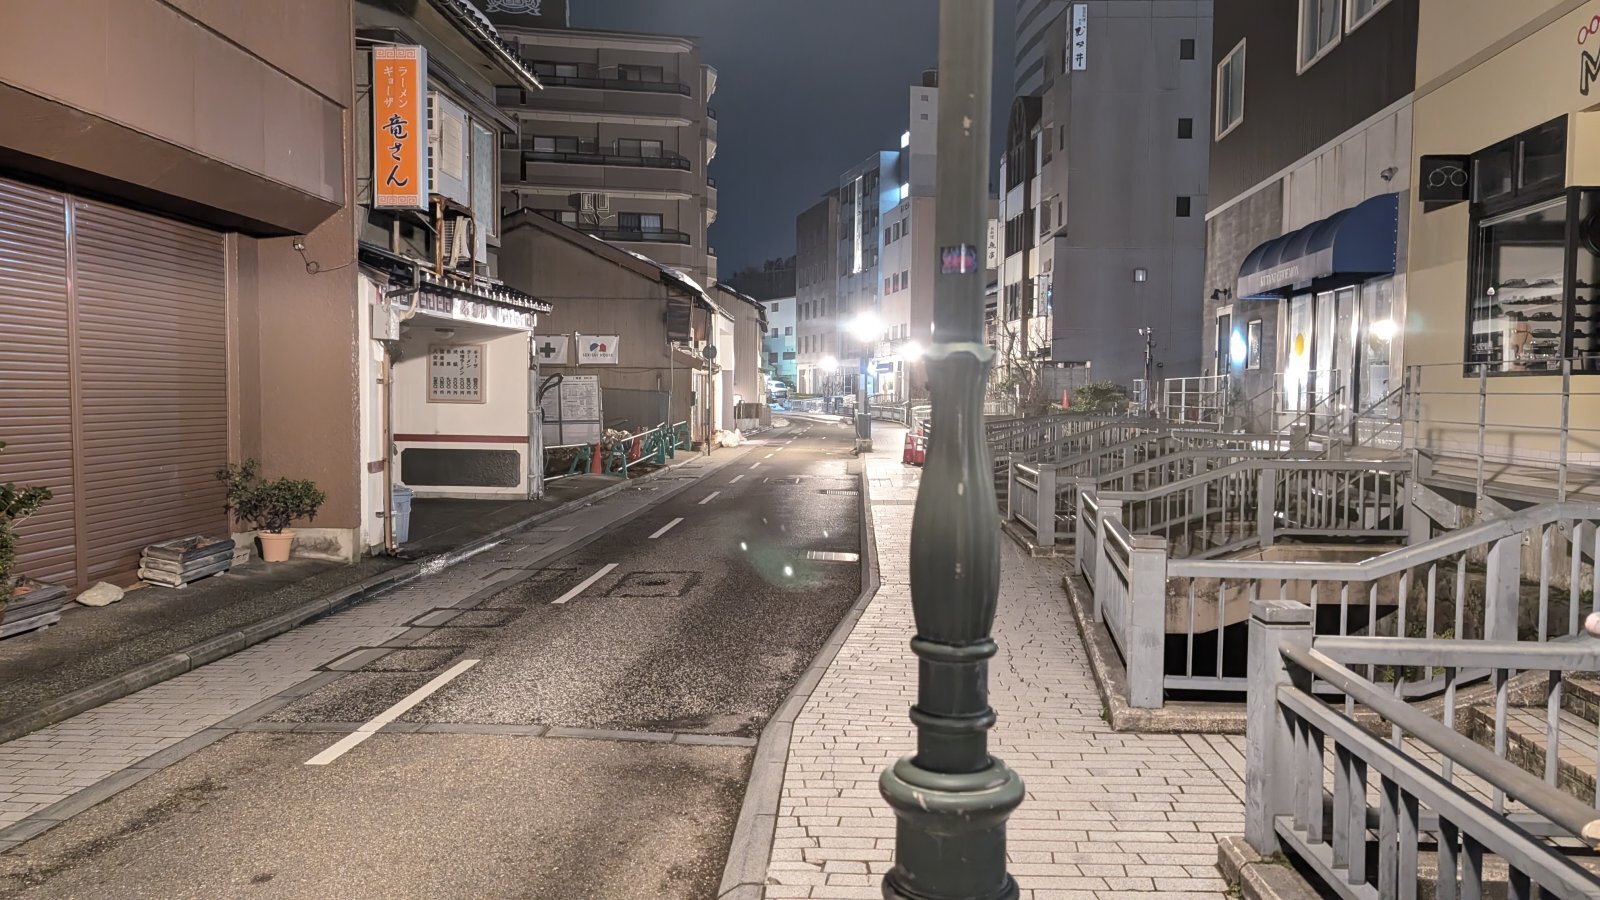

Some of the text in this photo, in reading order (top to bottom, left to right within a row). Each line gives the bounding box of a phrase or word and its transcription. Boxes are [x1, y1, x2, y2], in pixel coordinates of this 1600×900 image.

[383, 66, 394, 109] ギョーザ
[398, 66, 408, 108] ラーメン
[382, 113, 409, 187] 竜さん
